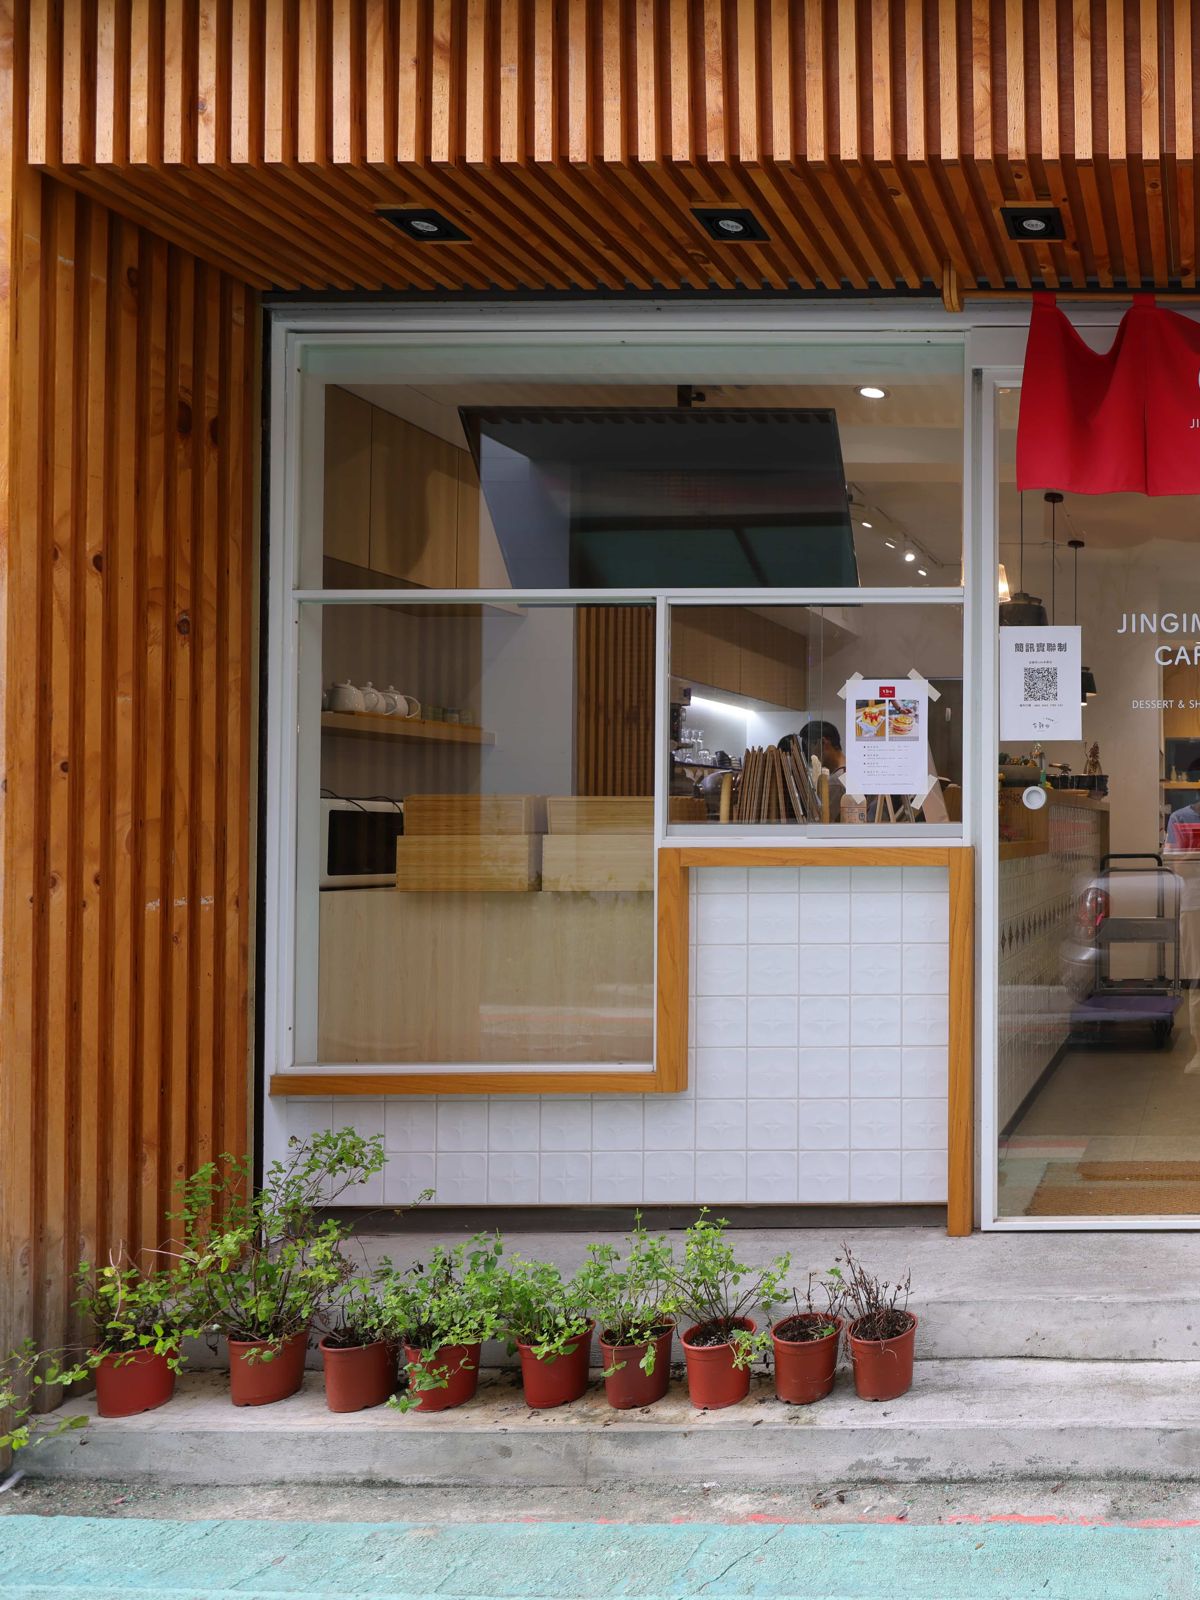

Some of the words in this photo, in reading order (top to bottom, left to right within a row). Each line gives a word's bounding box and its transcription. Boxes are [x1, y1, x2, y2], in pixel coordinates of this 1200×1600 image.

[1014, 642, 1067, 653] 簡訊實聯制
[1132, 700, 1174, 709] DESSERT
[1178, 700, 1185, 709] &
